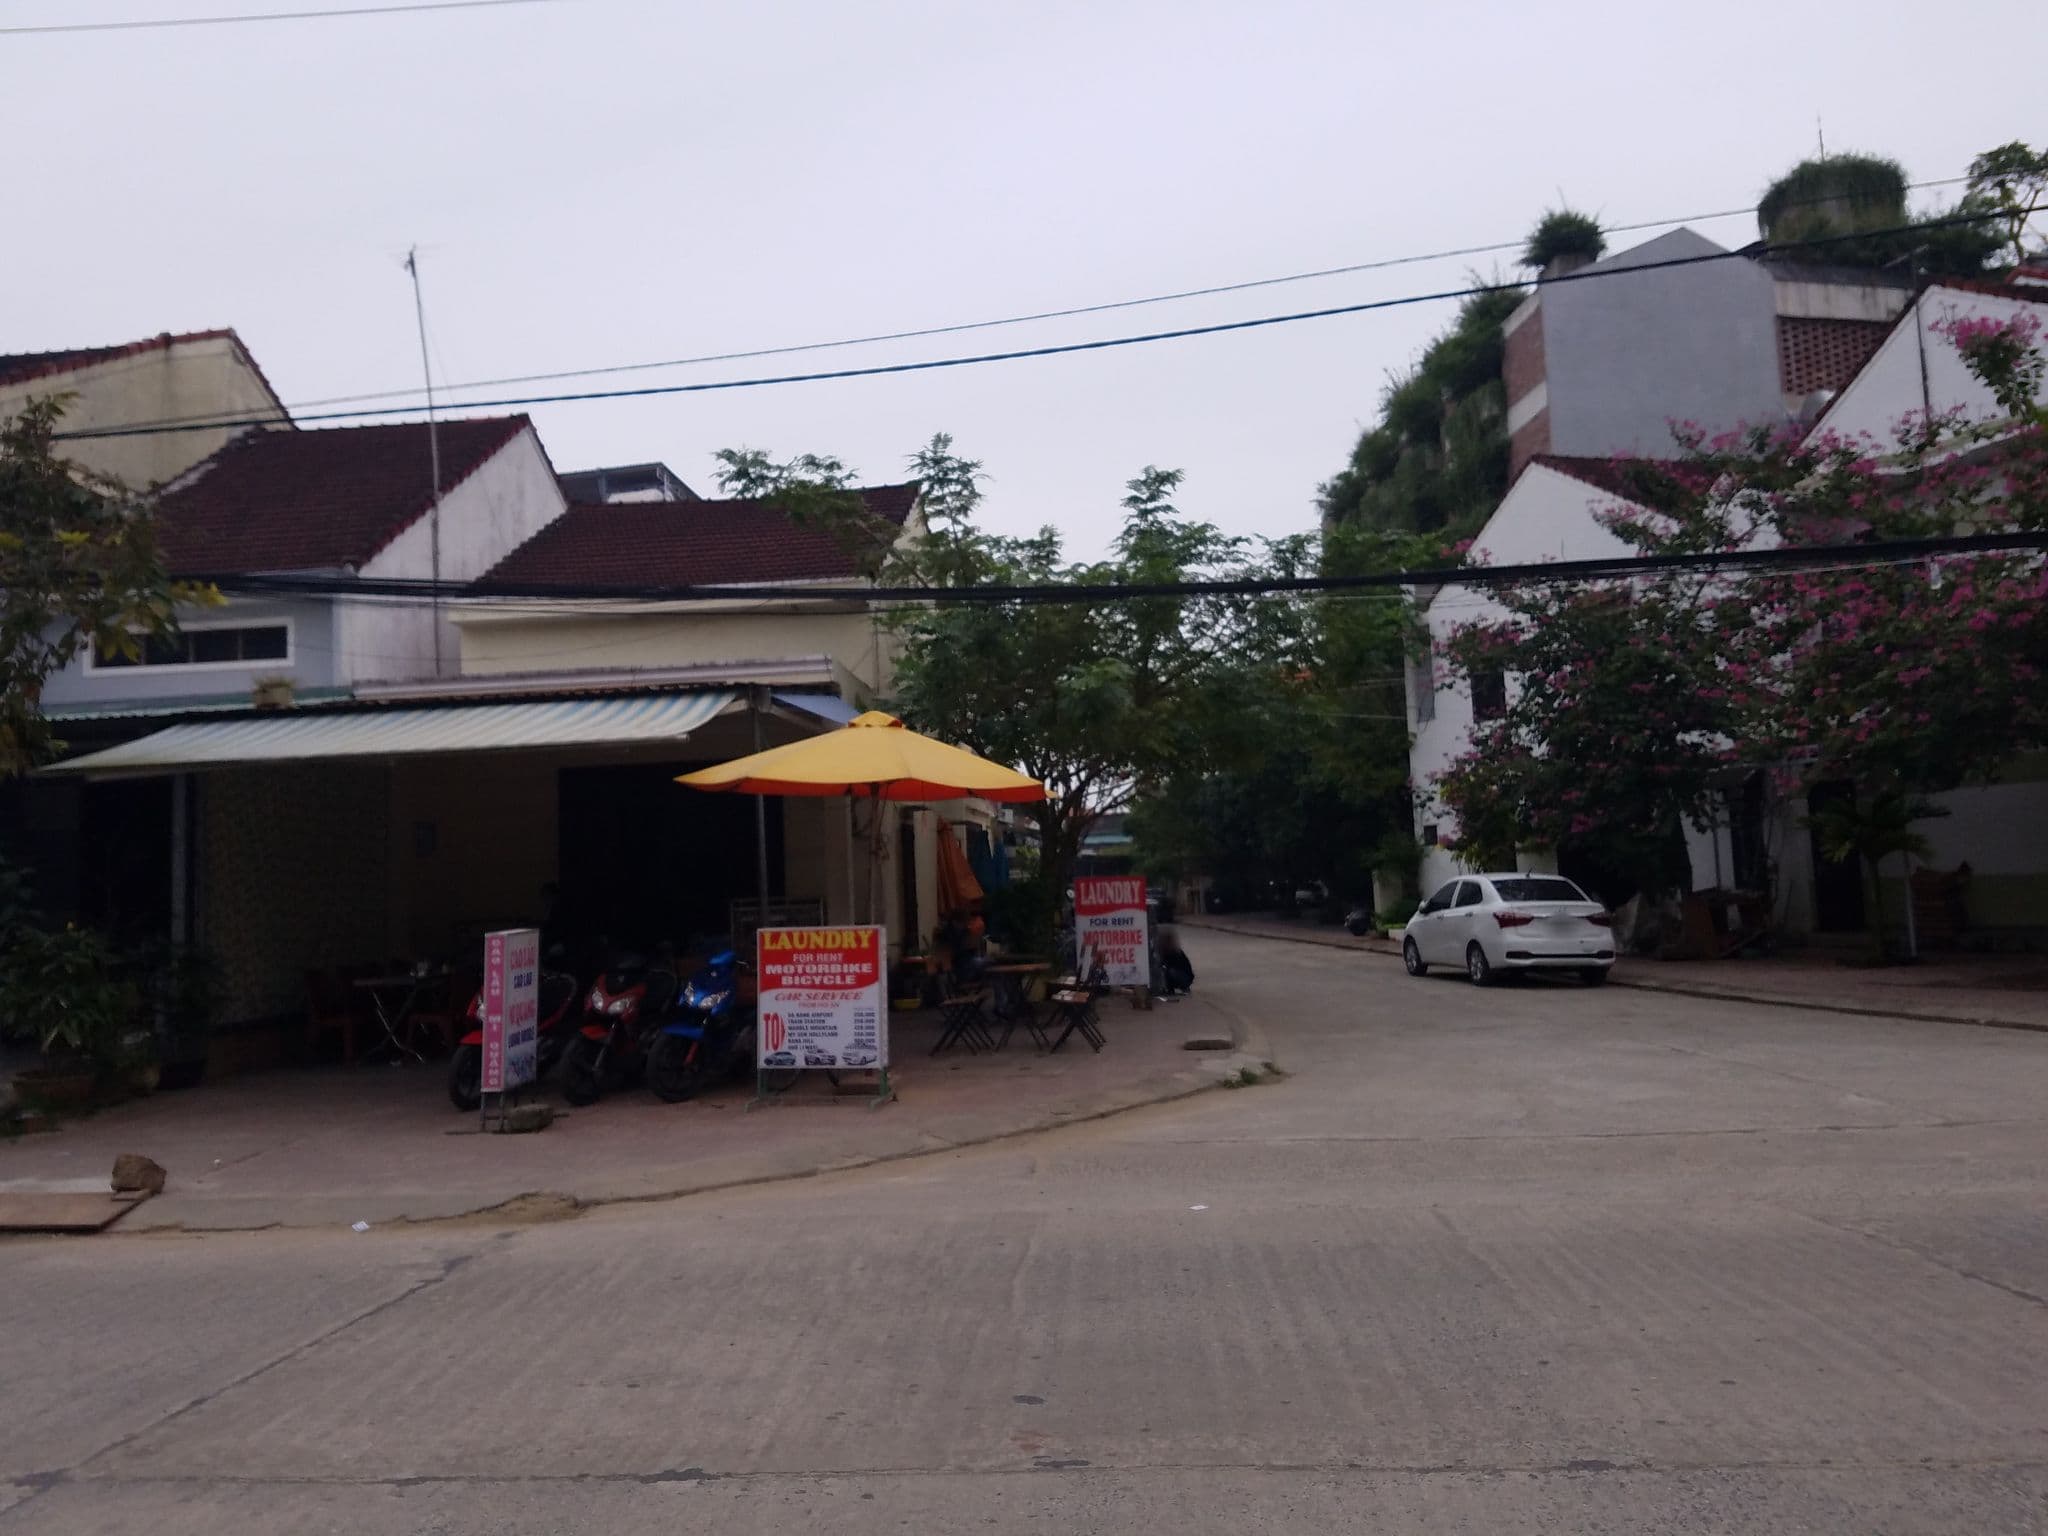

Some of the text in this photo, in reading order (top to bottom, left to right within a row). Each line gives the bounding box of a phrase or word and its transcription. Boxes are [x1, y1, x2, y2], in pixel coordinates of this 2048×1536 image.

[1080, 881, 1140, 905] LAUNDRY
[1089, 917, 1134, 926] FOR RENT
[763, 930, 873, 950] LAUNDRY
[1083, 930, 1142, 945] MOTORBIKE
[793, 953, 844, 962] FOR RENT
[765, 963, 873, 975] MOTORBIKE
[781, 975, 857, 985] BICYCLE
[775, 991, 864, 1001] CAR SERVICE
[763, 1013, 780, 1051] TO
